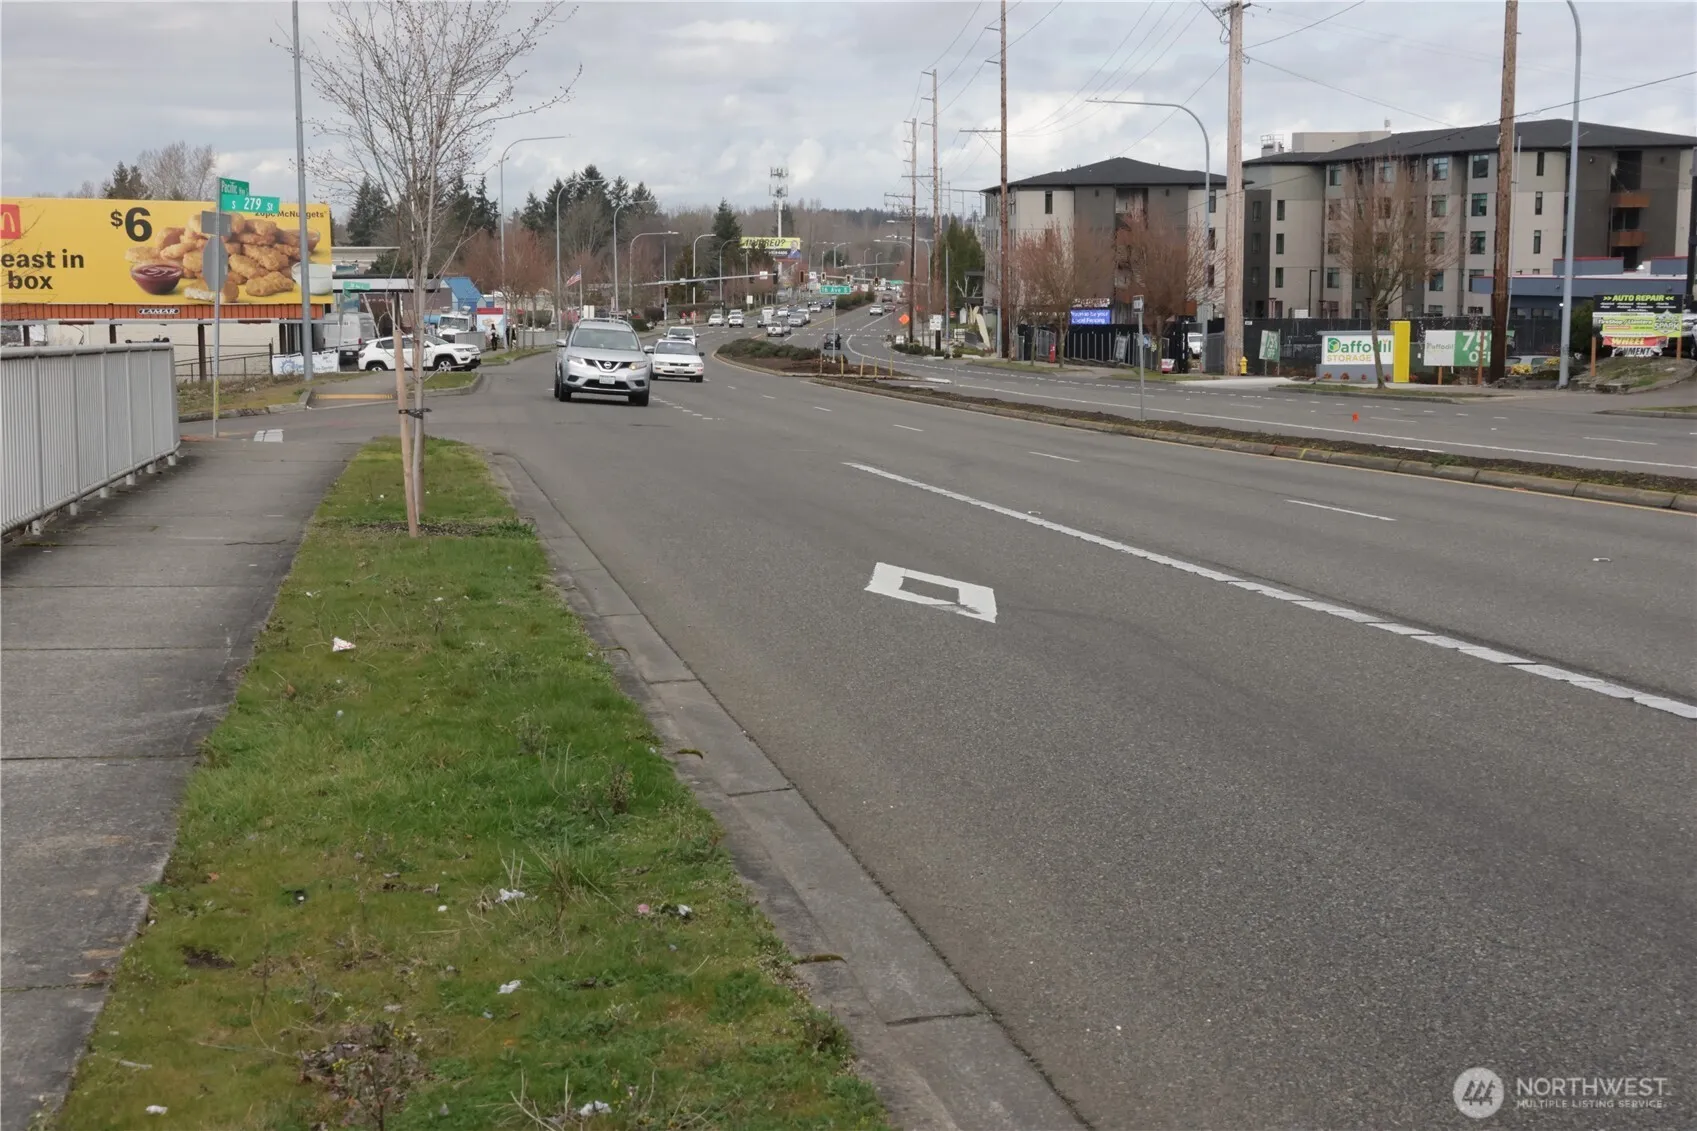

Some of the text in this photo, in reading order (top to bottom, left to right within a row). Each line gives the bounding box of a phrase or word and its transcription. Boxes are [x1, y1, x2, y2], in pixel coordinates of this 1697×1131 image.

[221, 181, 237, 194] Pacific
[231, 200, 236, 210] S
[244, 197, 262, 210] 279
[278, 210, 324, 219] McNugets
[110, 207, 153, 242] $6
[62, 249, 85, 269] in
[8, 271, 53, 290] box
[1612, 294, 1665, 302] AUTO REPAIR
[1654, 322, 1679, 330] SPARK
[1462, 332, 1492, 351] 75
[1612, 337, 1645, 345] WHEEL
